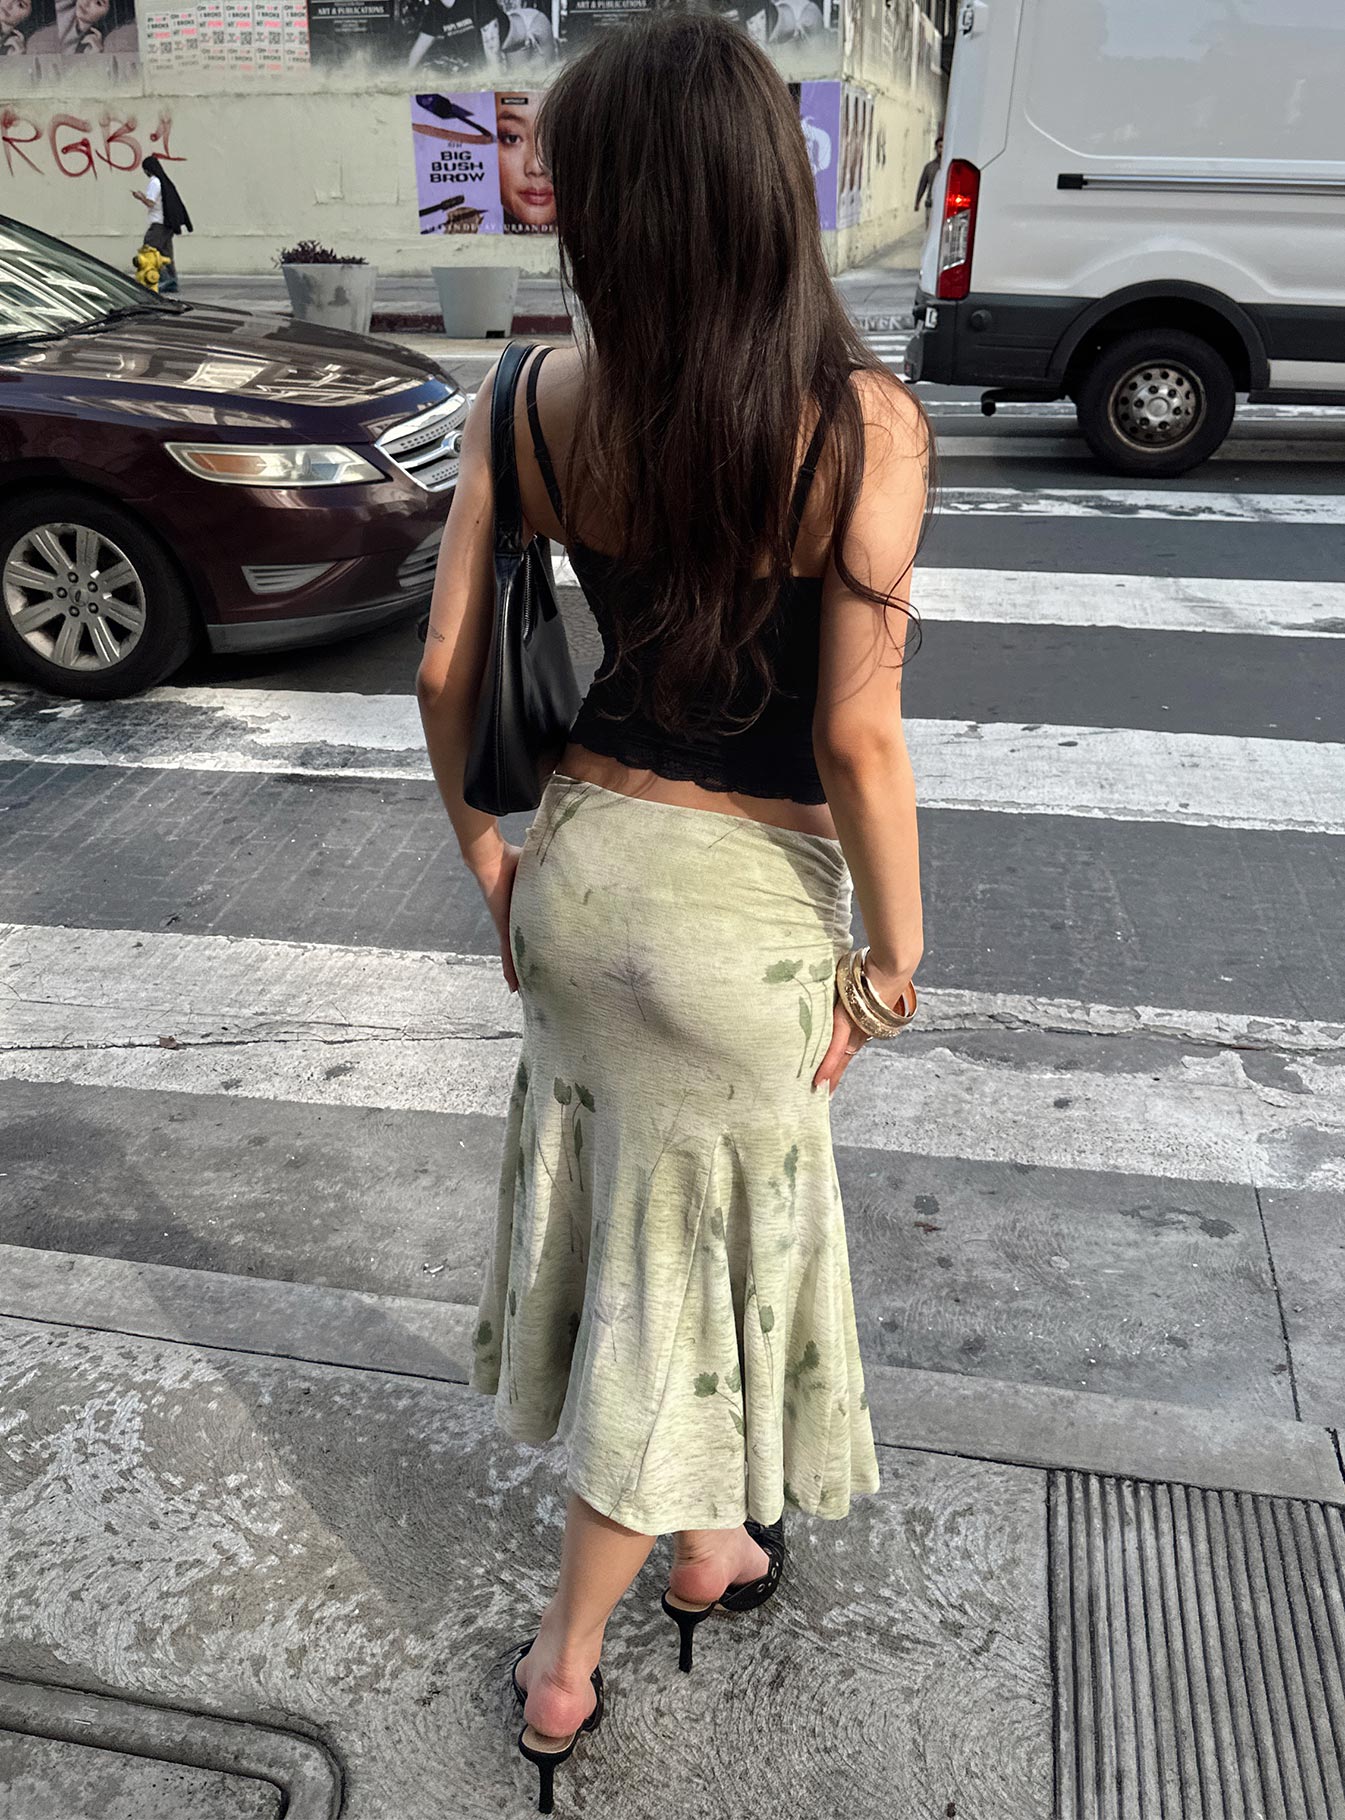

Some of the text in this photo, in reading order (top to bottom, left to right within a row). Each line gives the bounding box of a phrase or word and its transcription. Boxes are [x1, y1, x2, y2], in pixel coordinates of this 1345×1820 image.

[338, 6, 385, 14] PUBLICATIONS
[440, 151, 472, 161] BIG
[431, 162, 484, 172] BUSH
[430, 172, 486, 183] BROW
